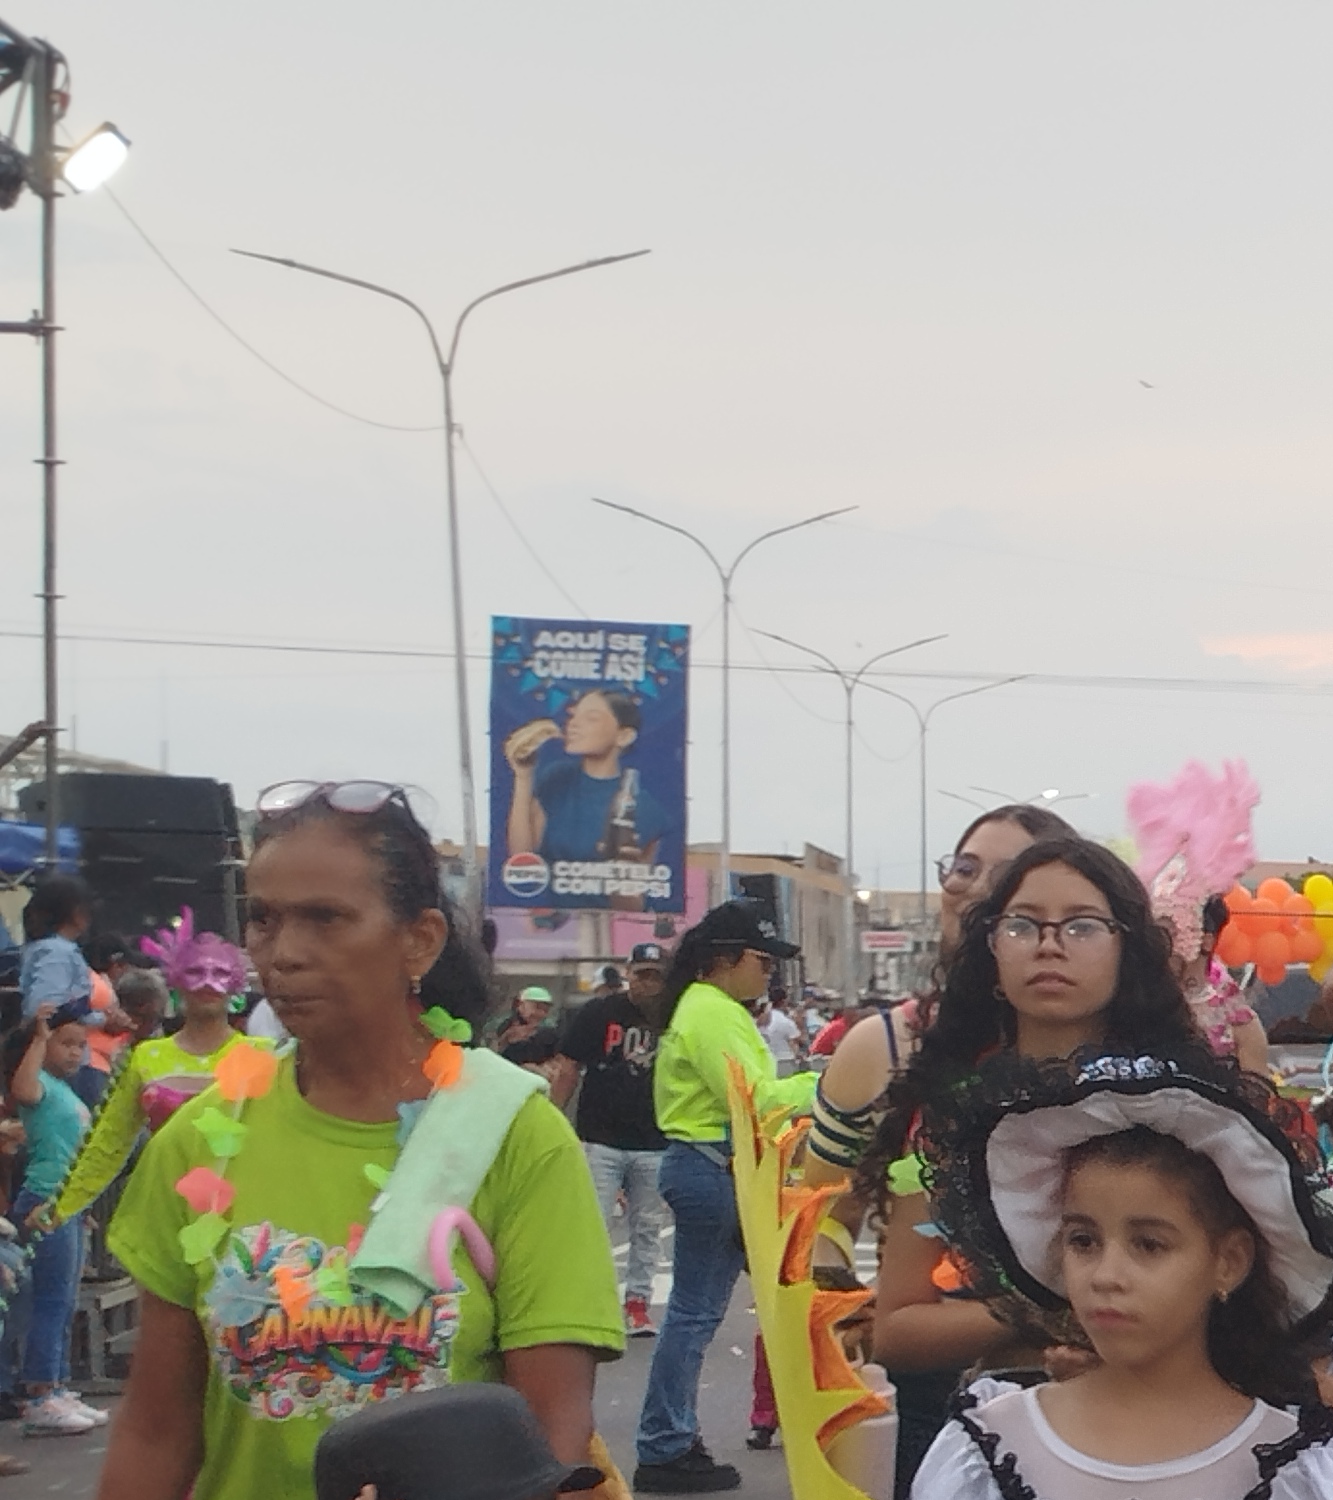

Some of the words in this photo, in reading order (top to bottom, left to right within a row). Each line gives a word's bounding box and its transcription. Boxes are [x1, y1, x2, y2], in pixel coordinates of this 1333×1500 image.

[607, 632, 648, 651] SE
[532, 650, 601, 679] COME
[553, 877, 603, 895] CON
[604, 879, 672, 898] PEPSI
